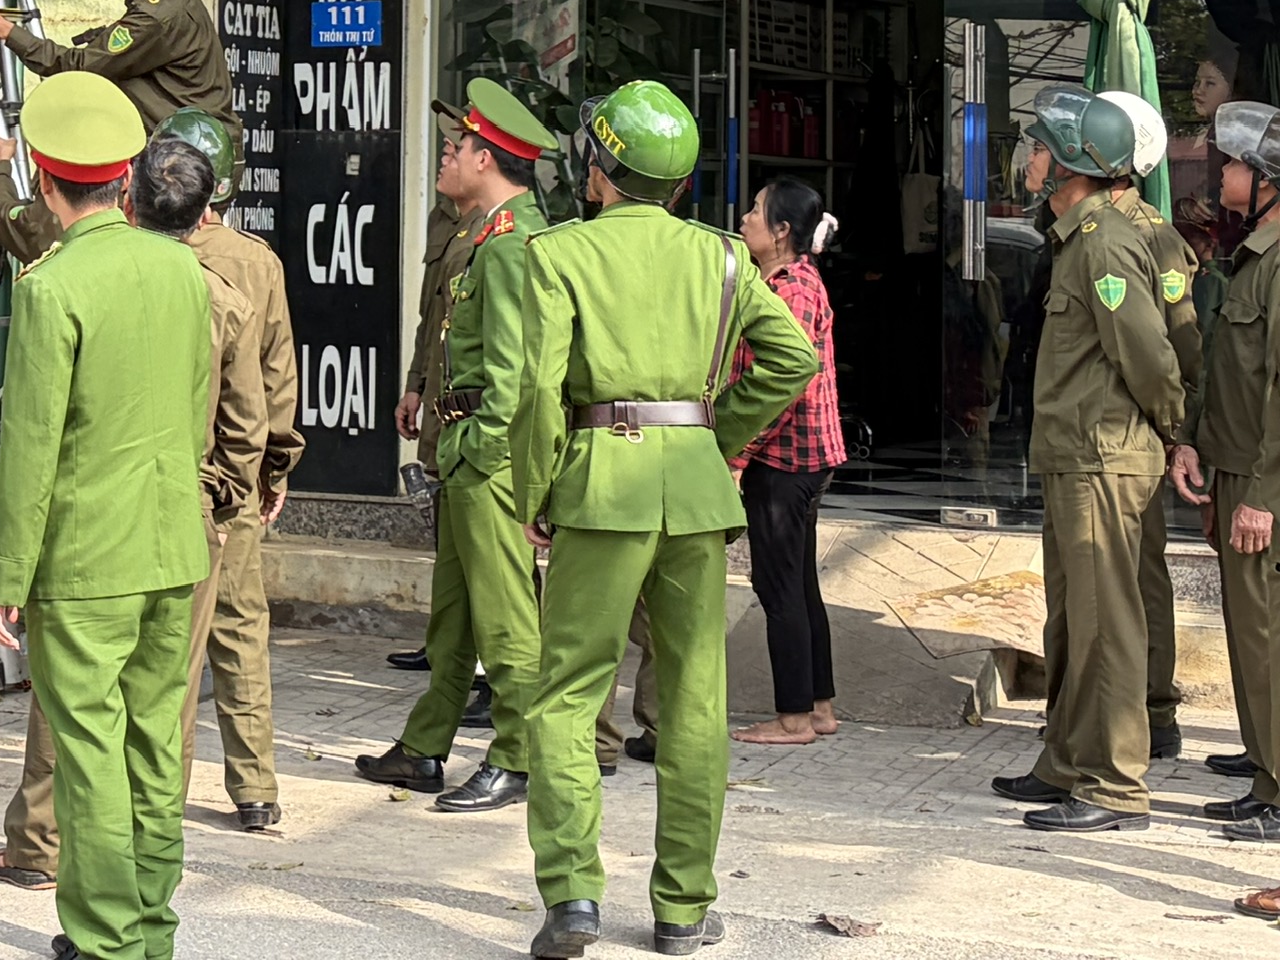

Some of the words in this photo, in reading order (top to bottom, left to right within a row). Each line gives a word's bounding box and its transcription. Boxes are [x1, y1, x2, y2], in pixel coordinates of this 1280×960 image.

[327, 5, 365, 25] 111
[319, 28, 343, 43] THÔN
[345, 30, 360, 45] THỊ
[362, 28, 375, 43] TỨ
[247, 46, 280, 81] NHUỘM
[232, 83, 247, 112] LÀ
[256, 85, 271, 113] ÉP
[293, 45, 391, 132] PHẨM
[594, 116, 626, 156] CSTT
[253, 167, 280, 193] STING
[306, 192, 375, 286] CÁC
[301, 344, 377, 436] LOẠI
